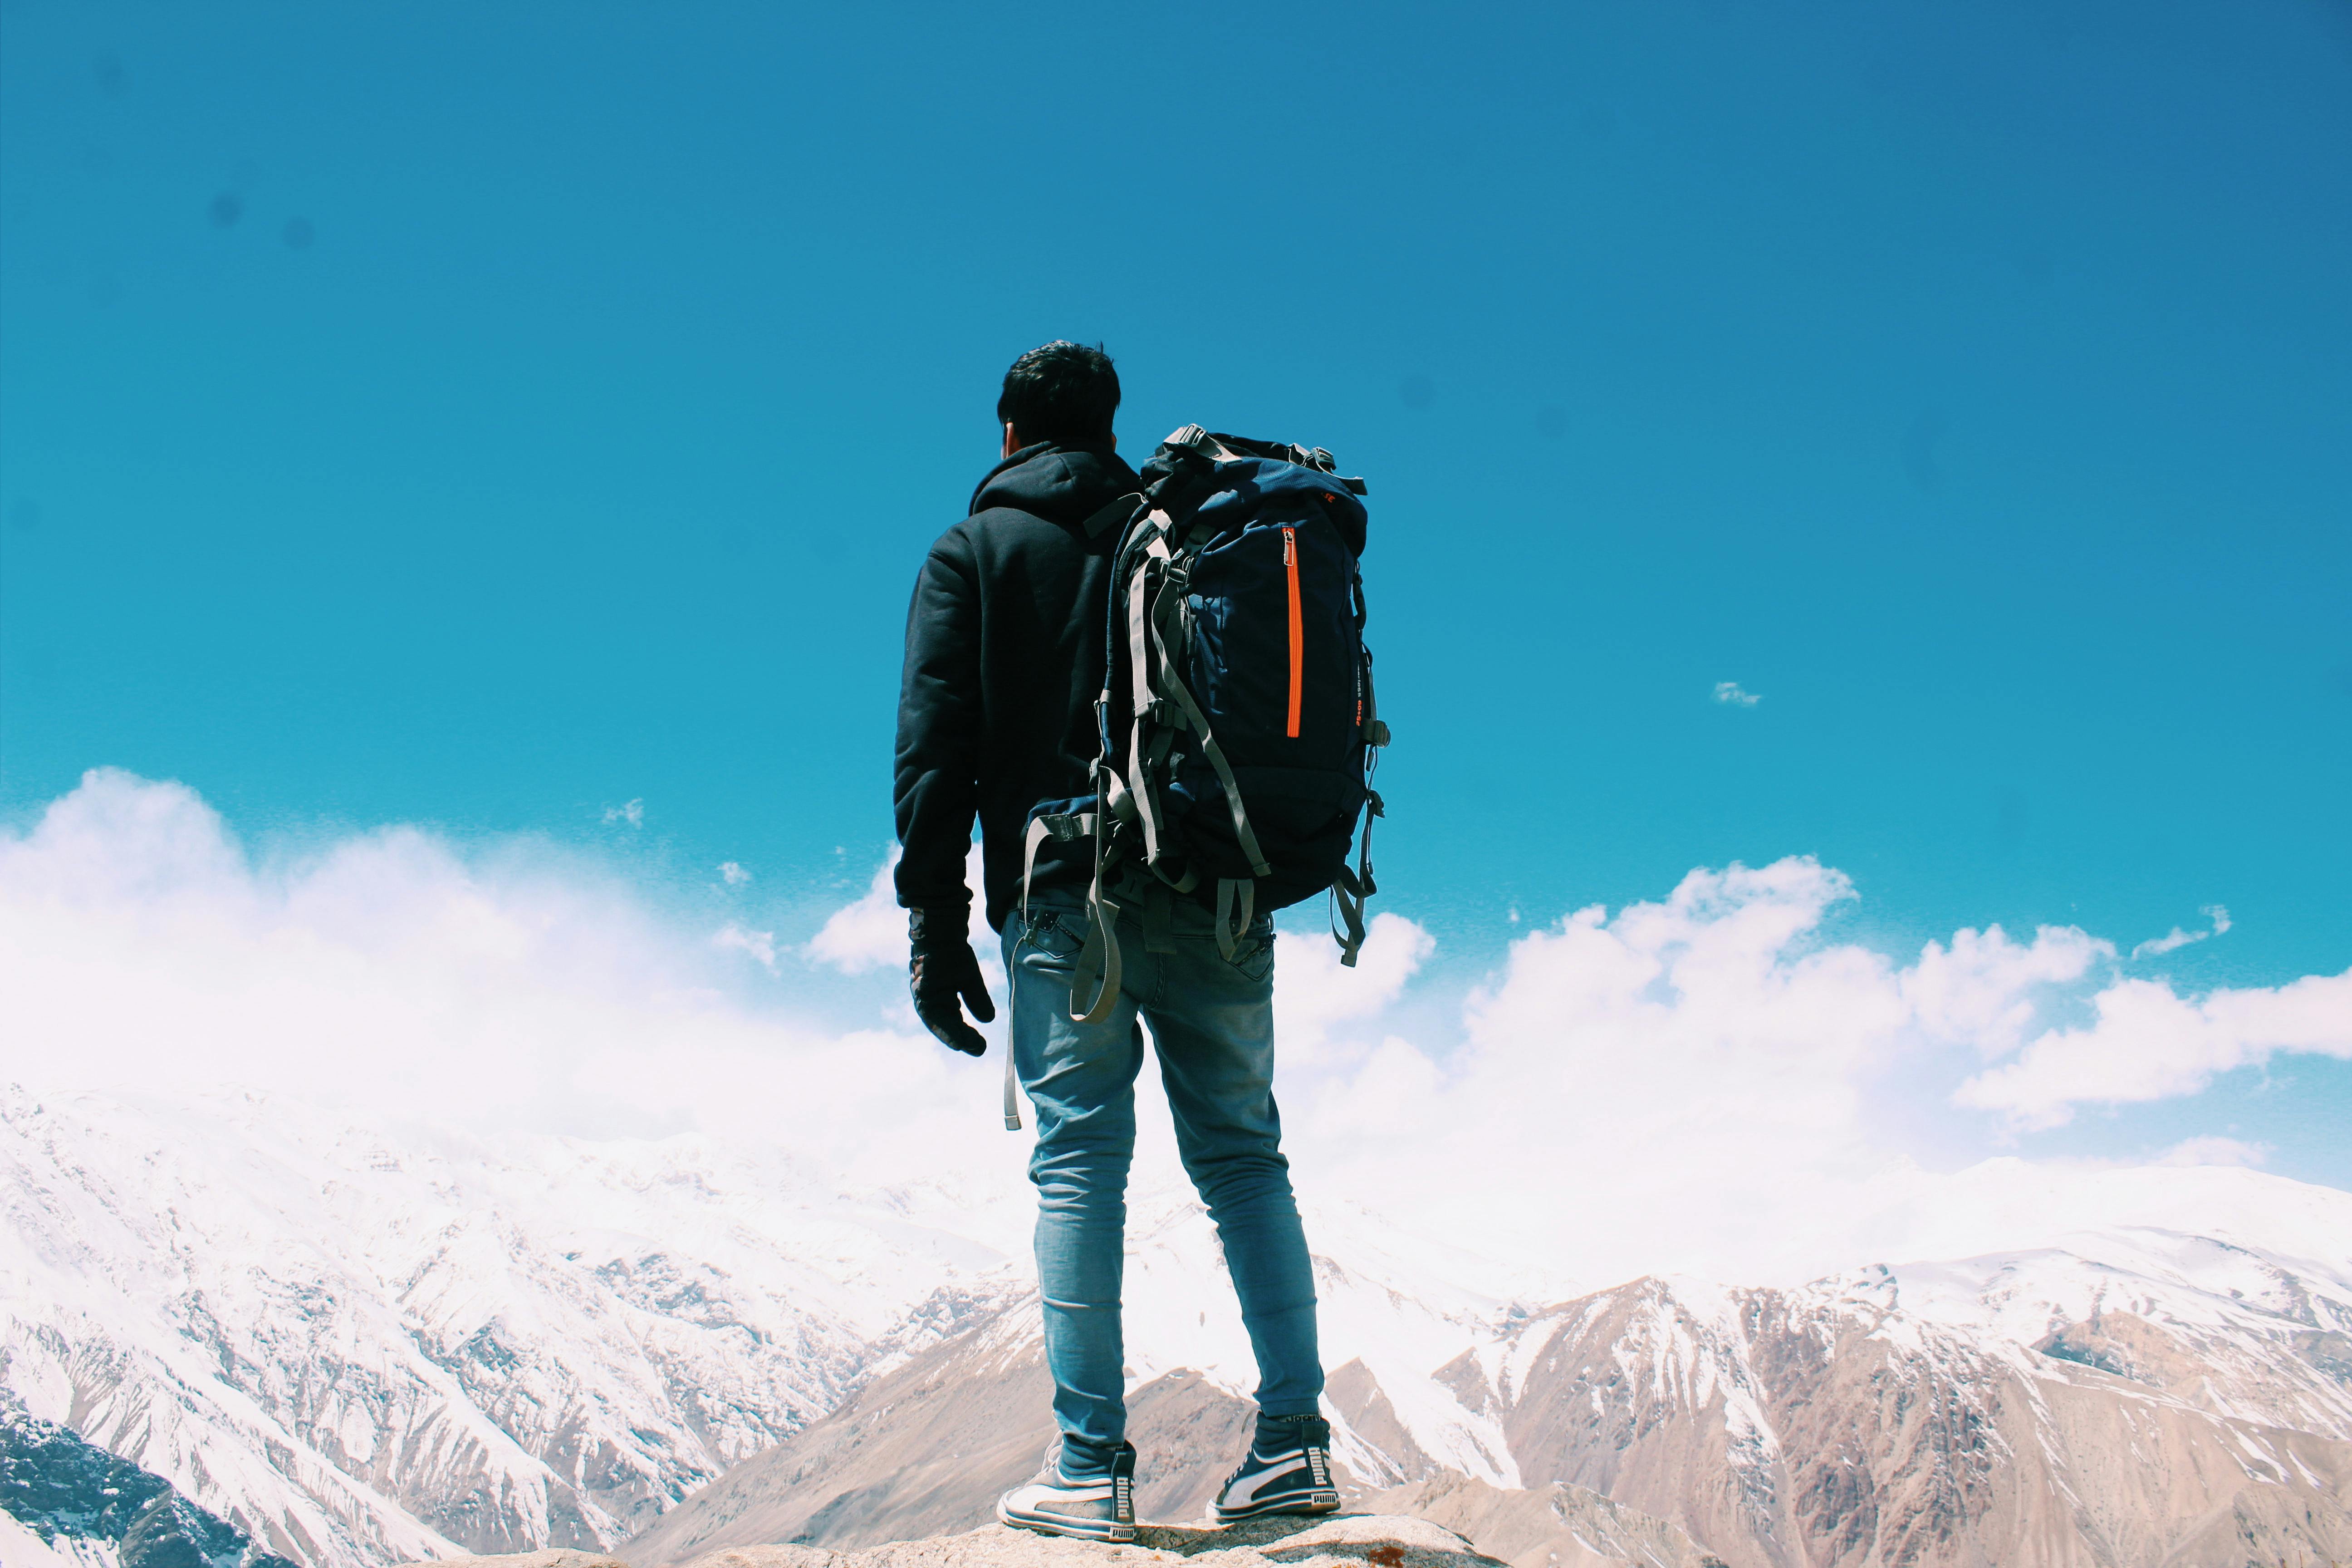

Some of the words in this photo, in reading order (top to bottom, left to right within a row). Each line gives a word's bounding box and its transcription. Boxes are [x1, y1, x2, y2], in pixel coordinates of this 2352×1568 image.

[1308, 1446, 1328, 1485] PUMA
[1117, 1476, 1130, 1517] PUMA
[1113, 1529, 1133, 1538] PUMA
